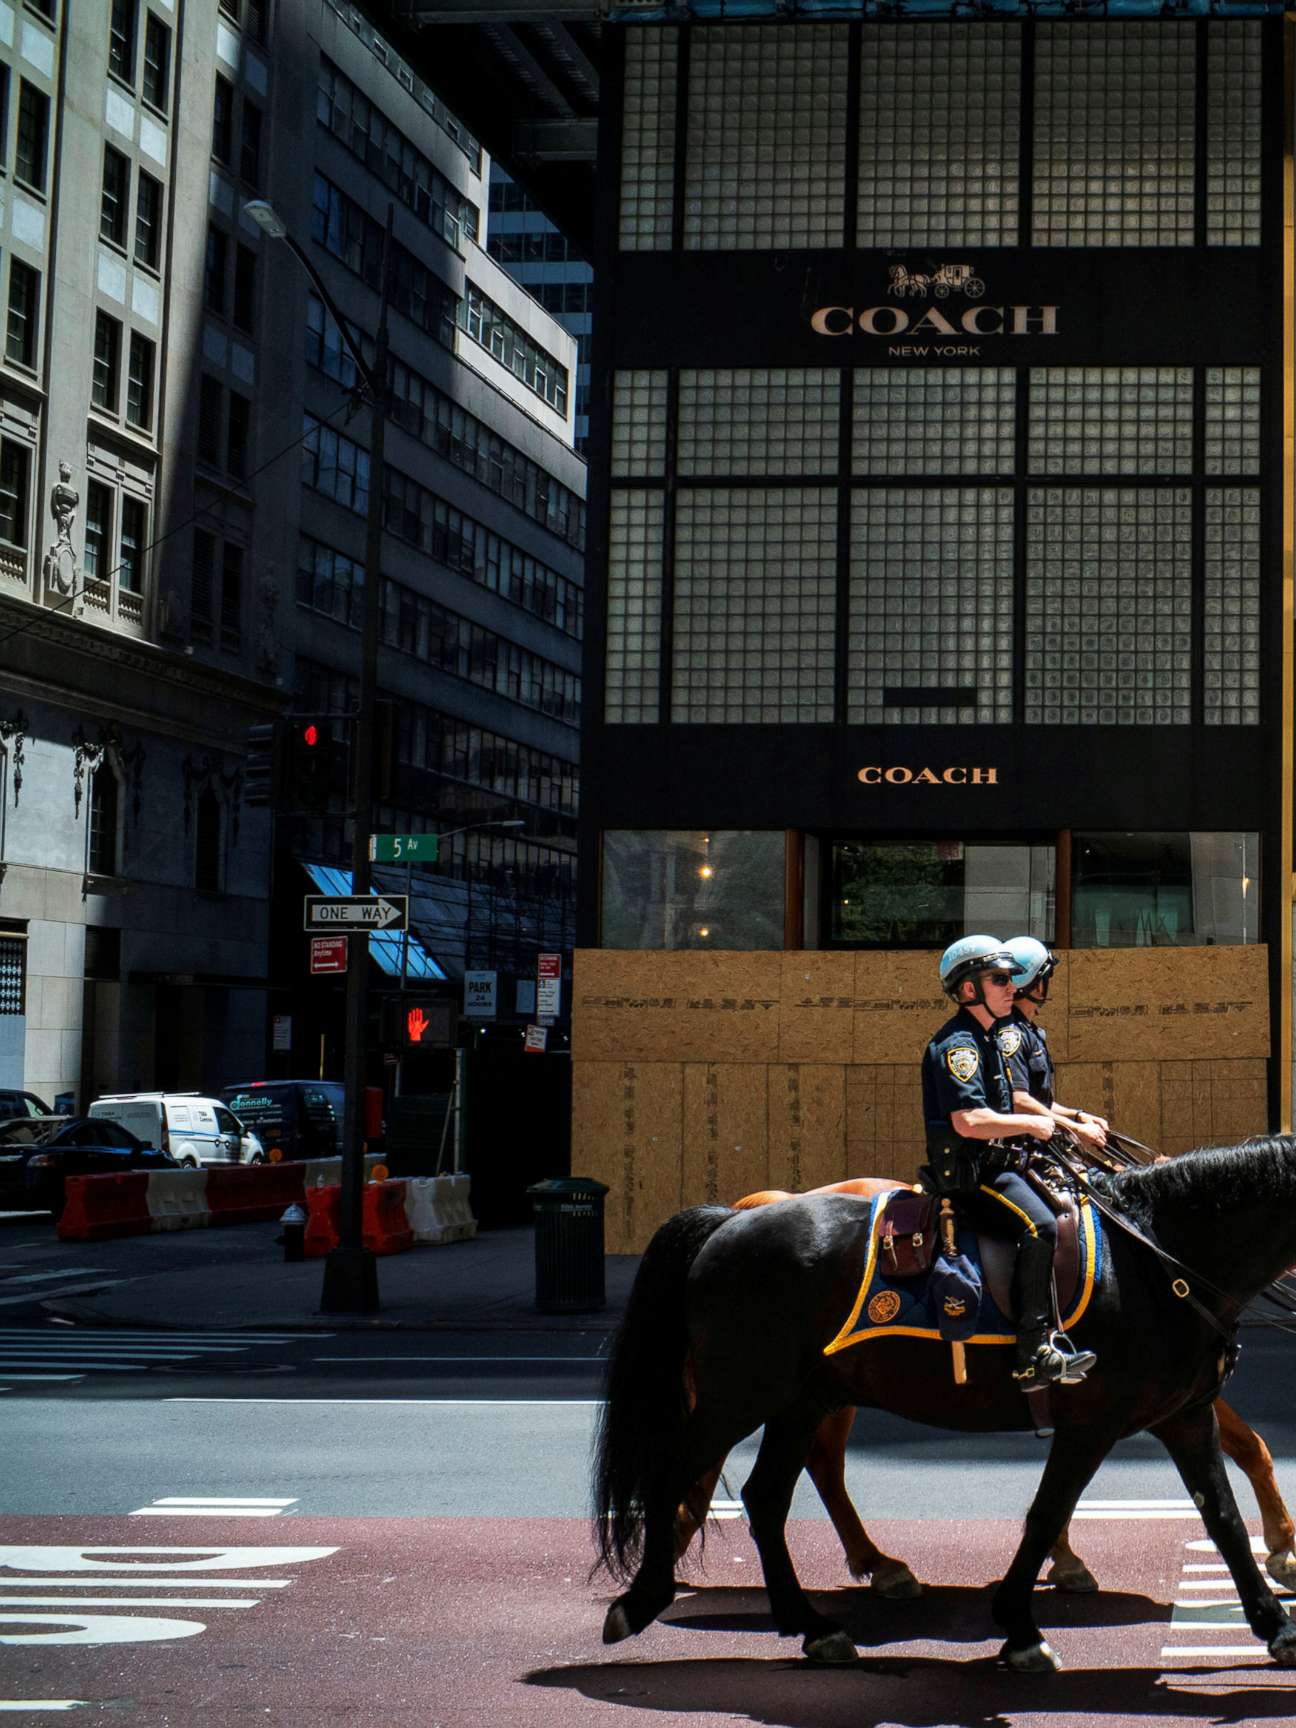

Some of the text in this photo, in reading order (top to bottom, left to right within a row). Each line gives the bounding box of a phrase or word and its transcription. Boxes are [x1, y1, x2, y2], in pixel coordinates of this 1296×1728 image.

[809, 304, 1061, 337] COACH
[888, 345, 981, 358] NEW YORK
[856, 766, 999, 785] COACH
[393, 838, 402, 858] 5
[320, 906, 391, 920] ONE WAY
[468, 981, 492, 993] PARK
